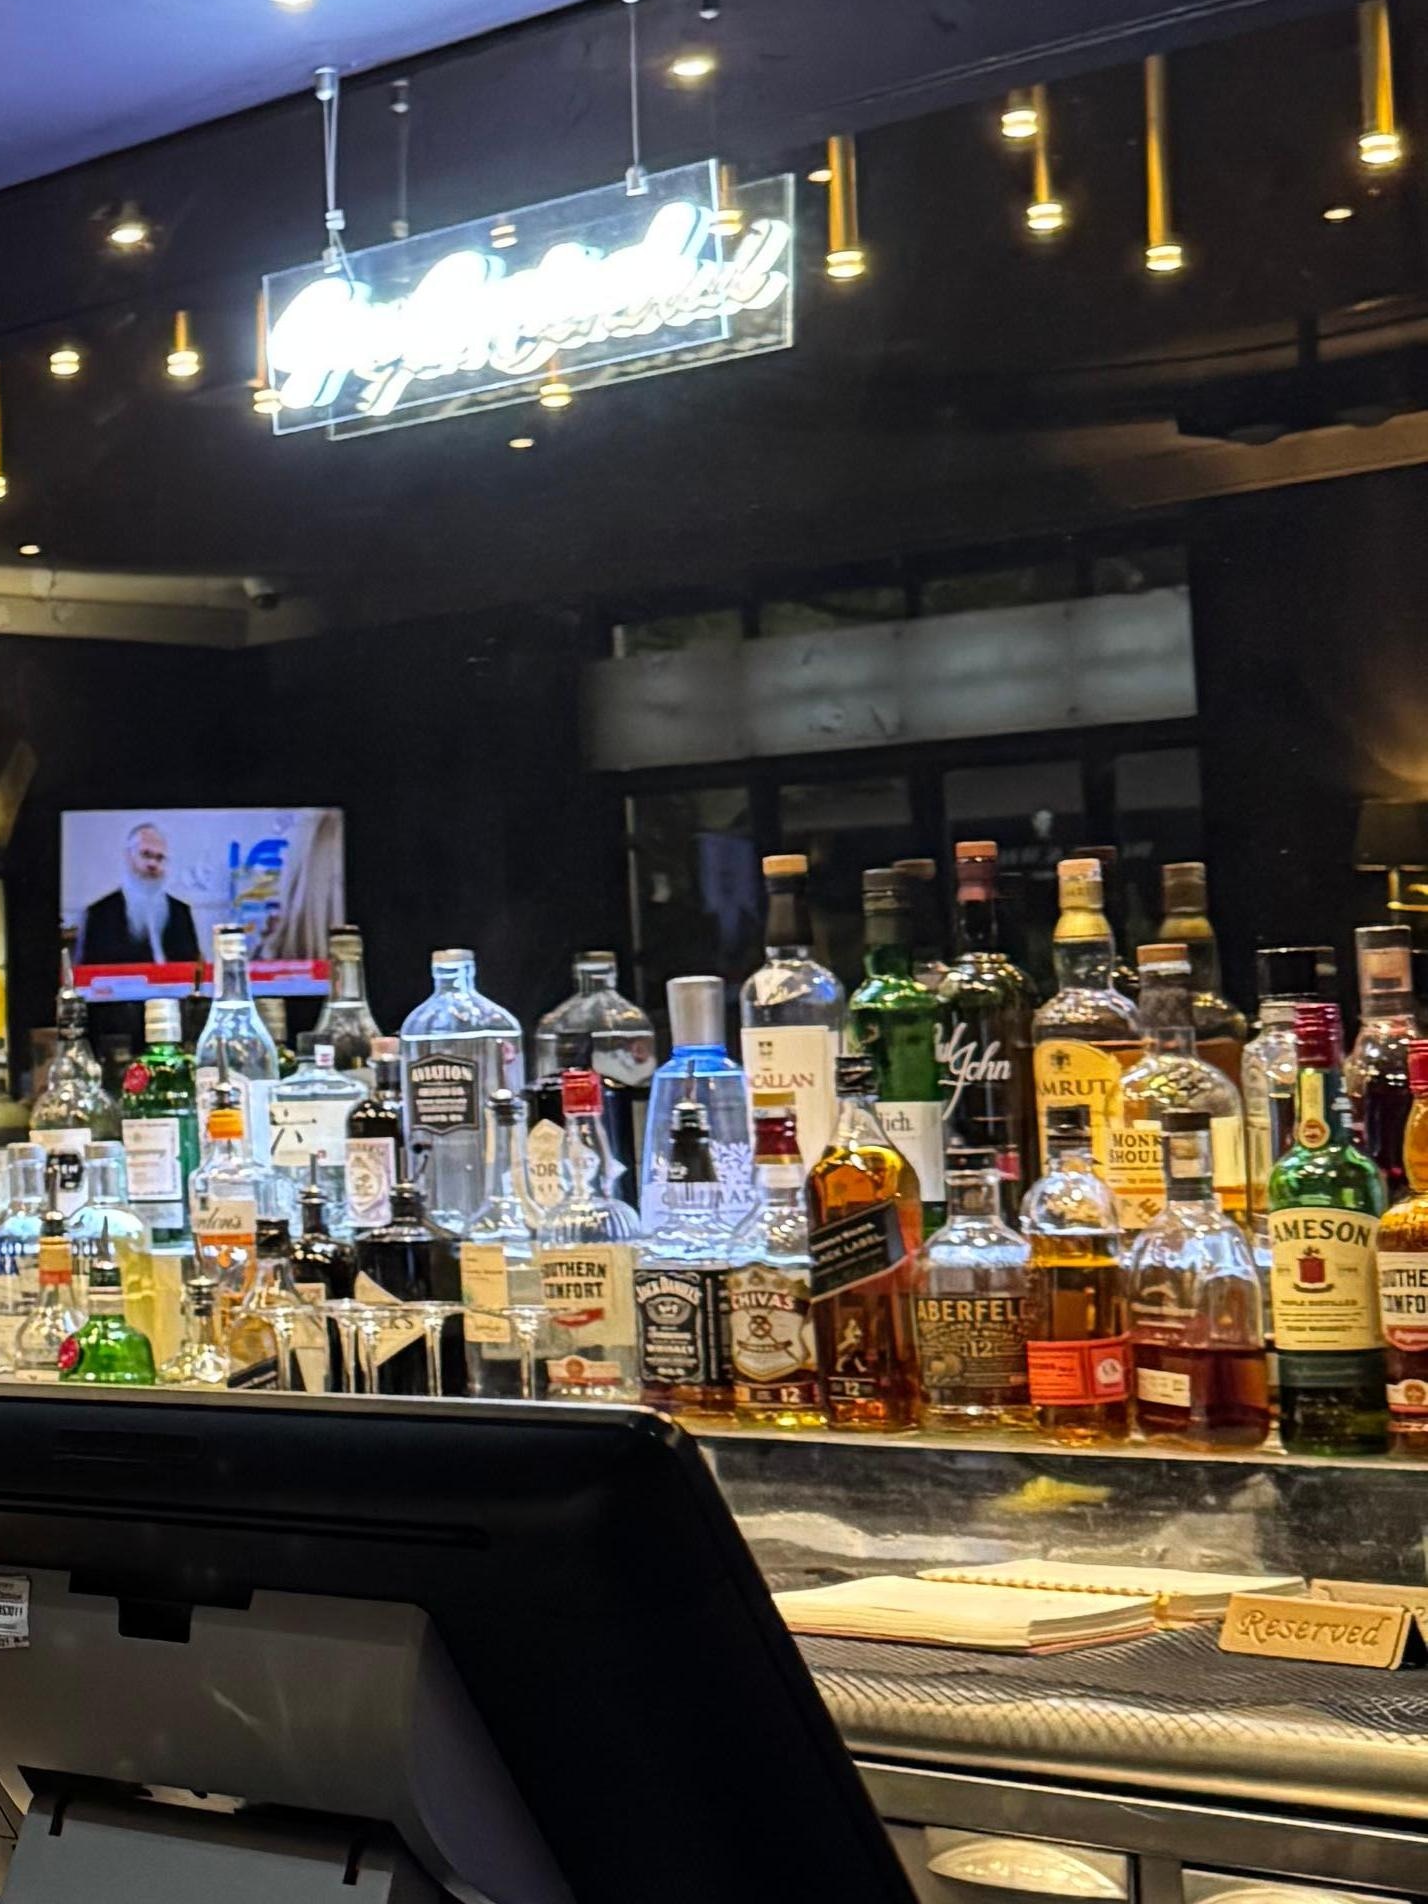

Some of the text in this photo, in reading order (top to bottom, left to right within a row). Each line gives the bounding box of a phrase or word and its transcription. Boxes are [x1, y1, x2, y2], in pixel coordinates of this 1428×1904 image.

[412, 1065, 474, 1082] AVIATION
[750, 1073, 815, 1089] CALLAN
[1109, 1149, 1162, 1164] SHOUL
[1274, 1219, 1371, 1247] AMESON
[732, 1293, 794, 1310] CHIVAS
[781, 1387, 800, 1403] 12
[1237, 1609, 1393, 1647] Reserved
